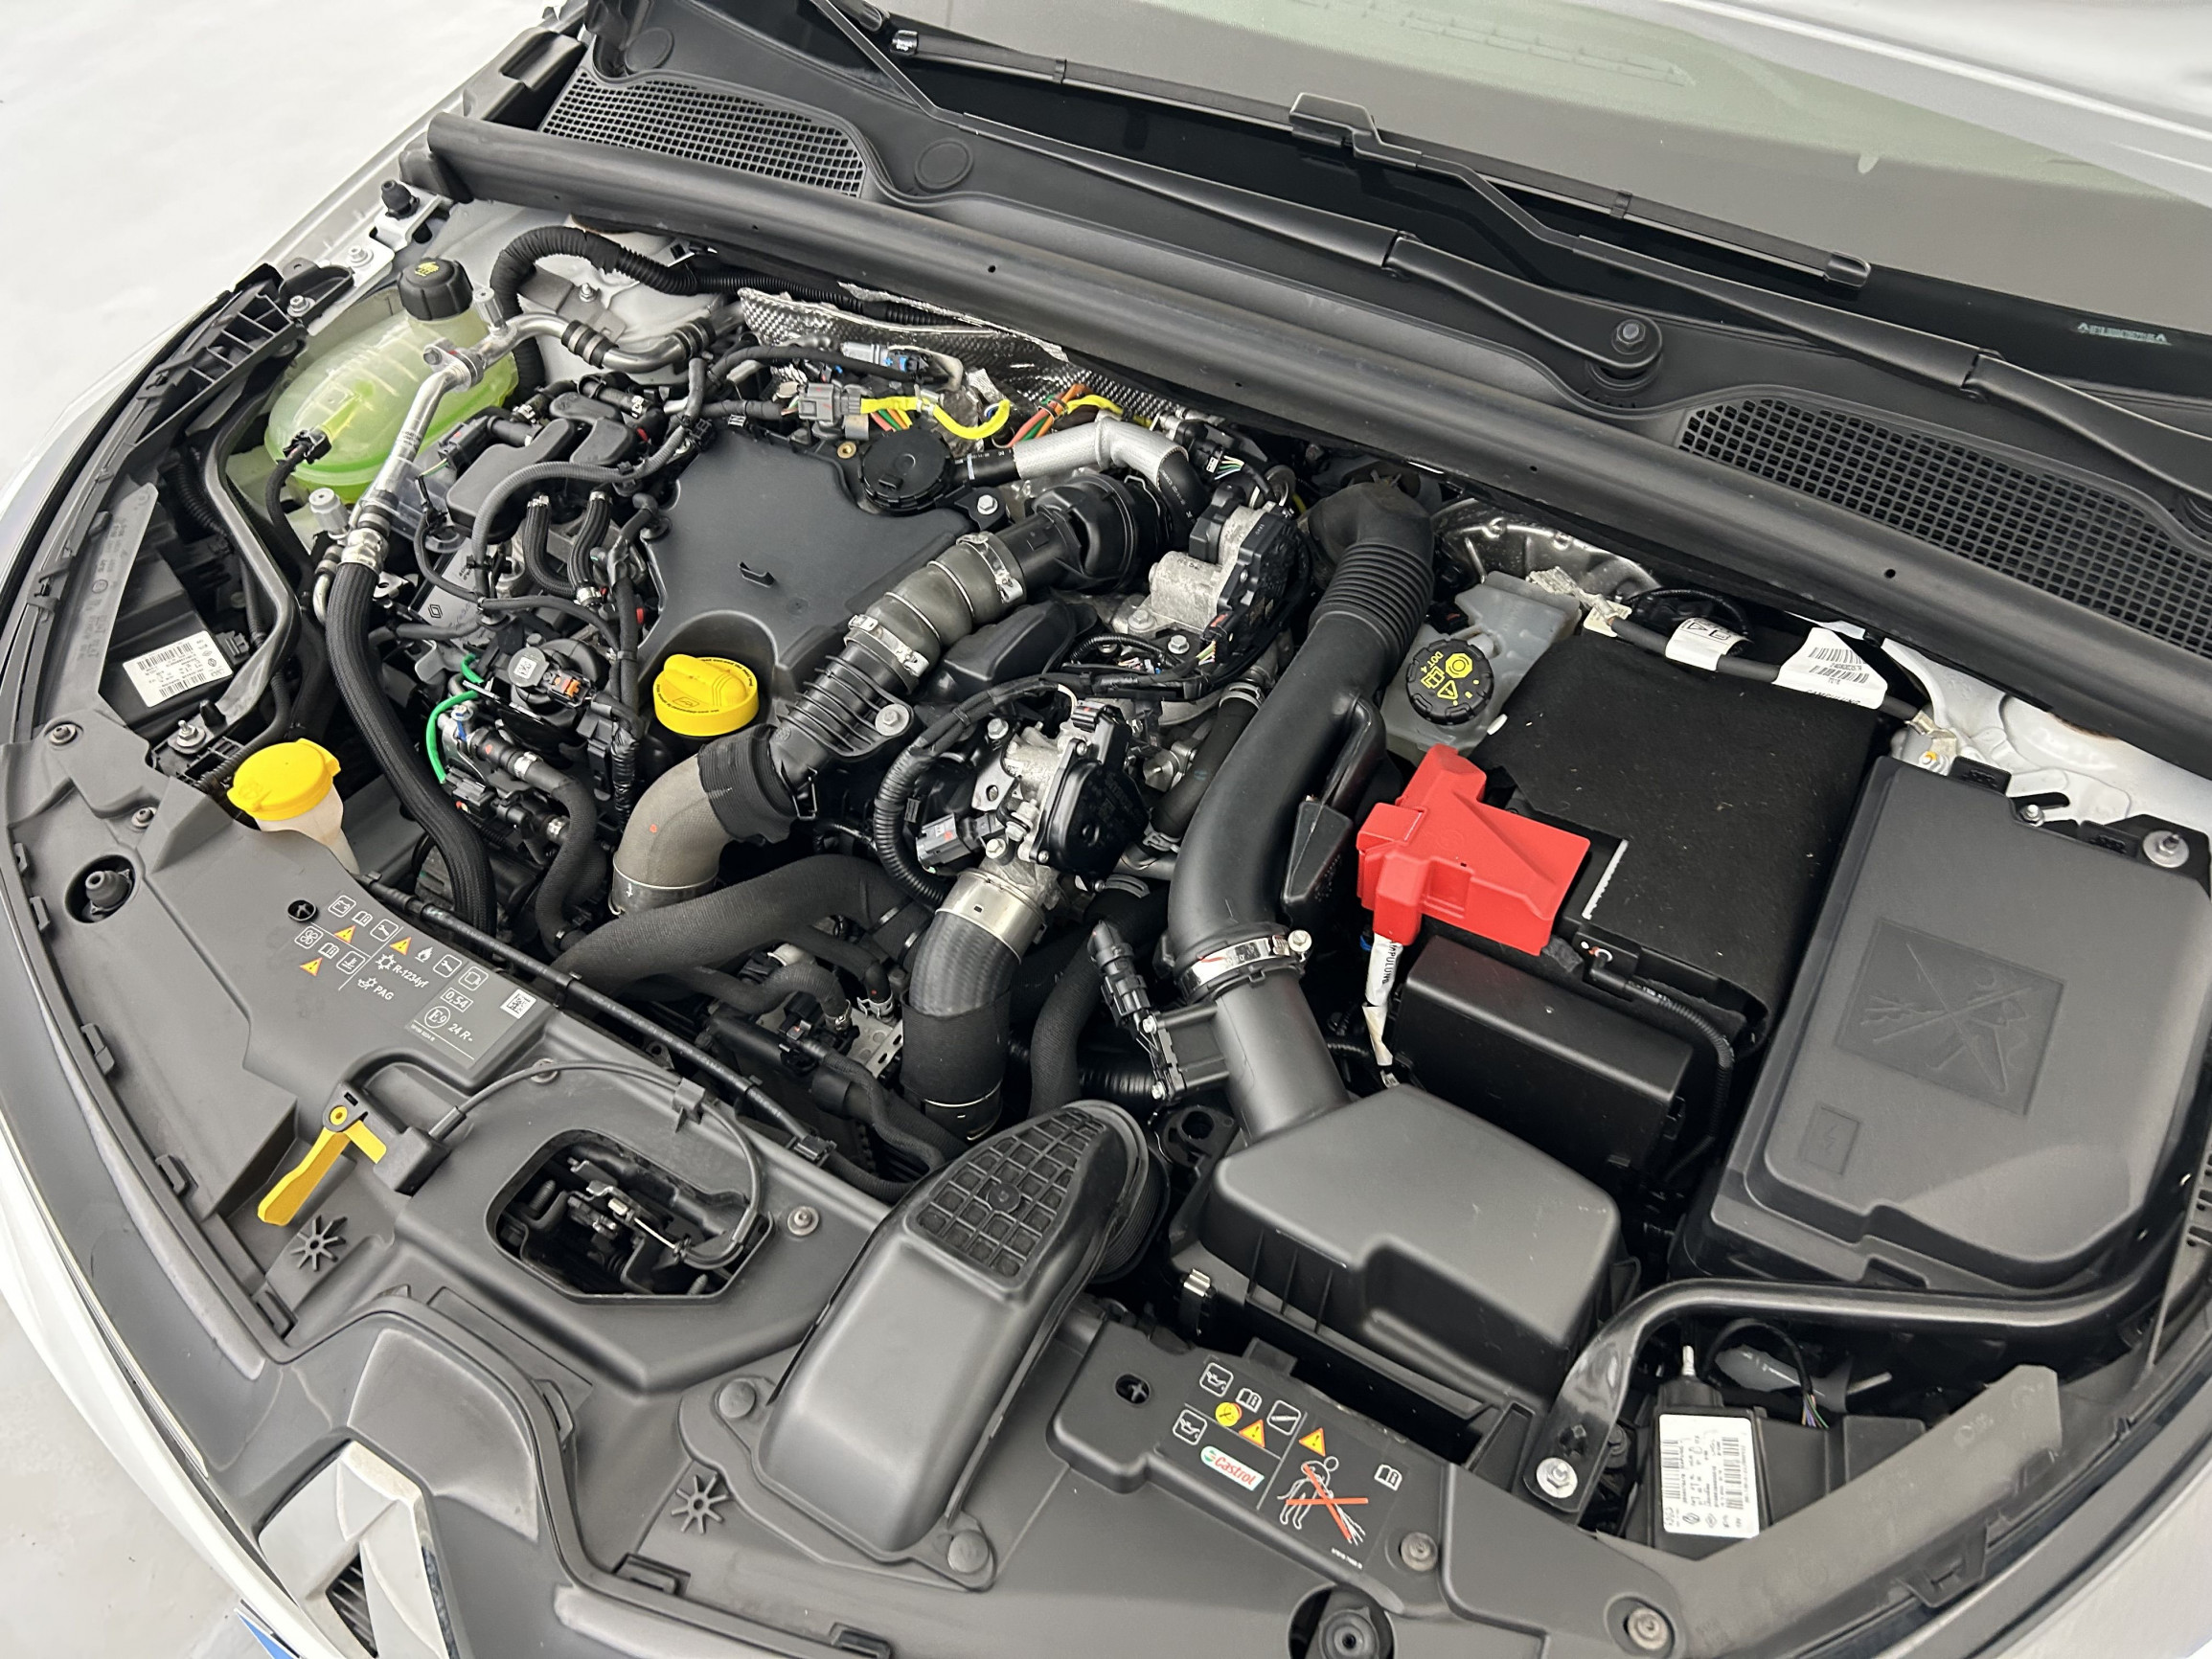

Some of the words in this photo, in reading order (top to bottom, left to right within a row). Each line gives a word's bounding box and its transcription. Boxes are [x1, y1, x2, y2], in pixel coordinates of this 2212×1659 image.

[1427, 651, 1444, 668] DOT
[393, 965, 428, 988] R-1234yf
[374, 986, 394, 1000] PAG
[445, 991, 469, 1009] 0,54
[448, 1023, 461, 1035] 24
[1215, 1457, 1256, 1485] Castrol
